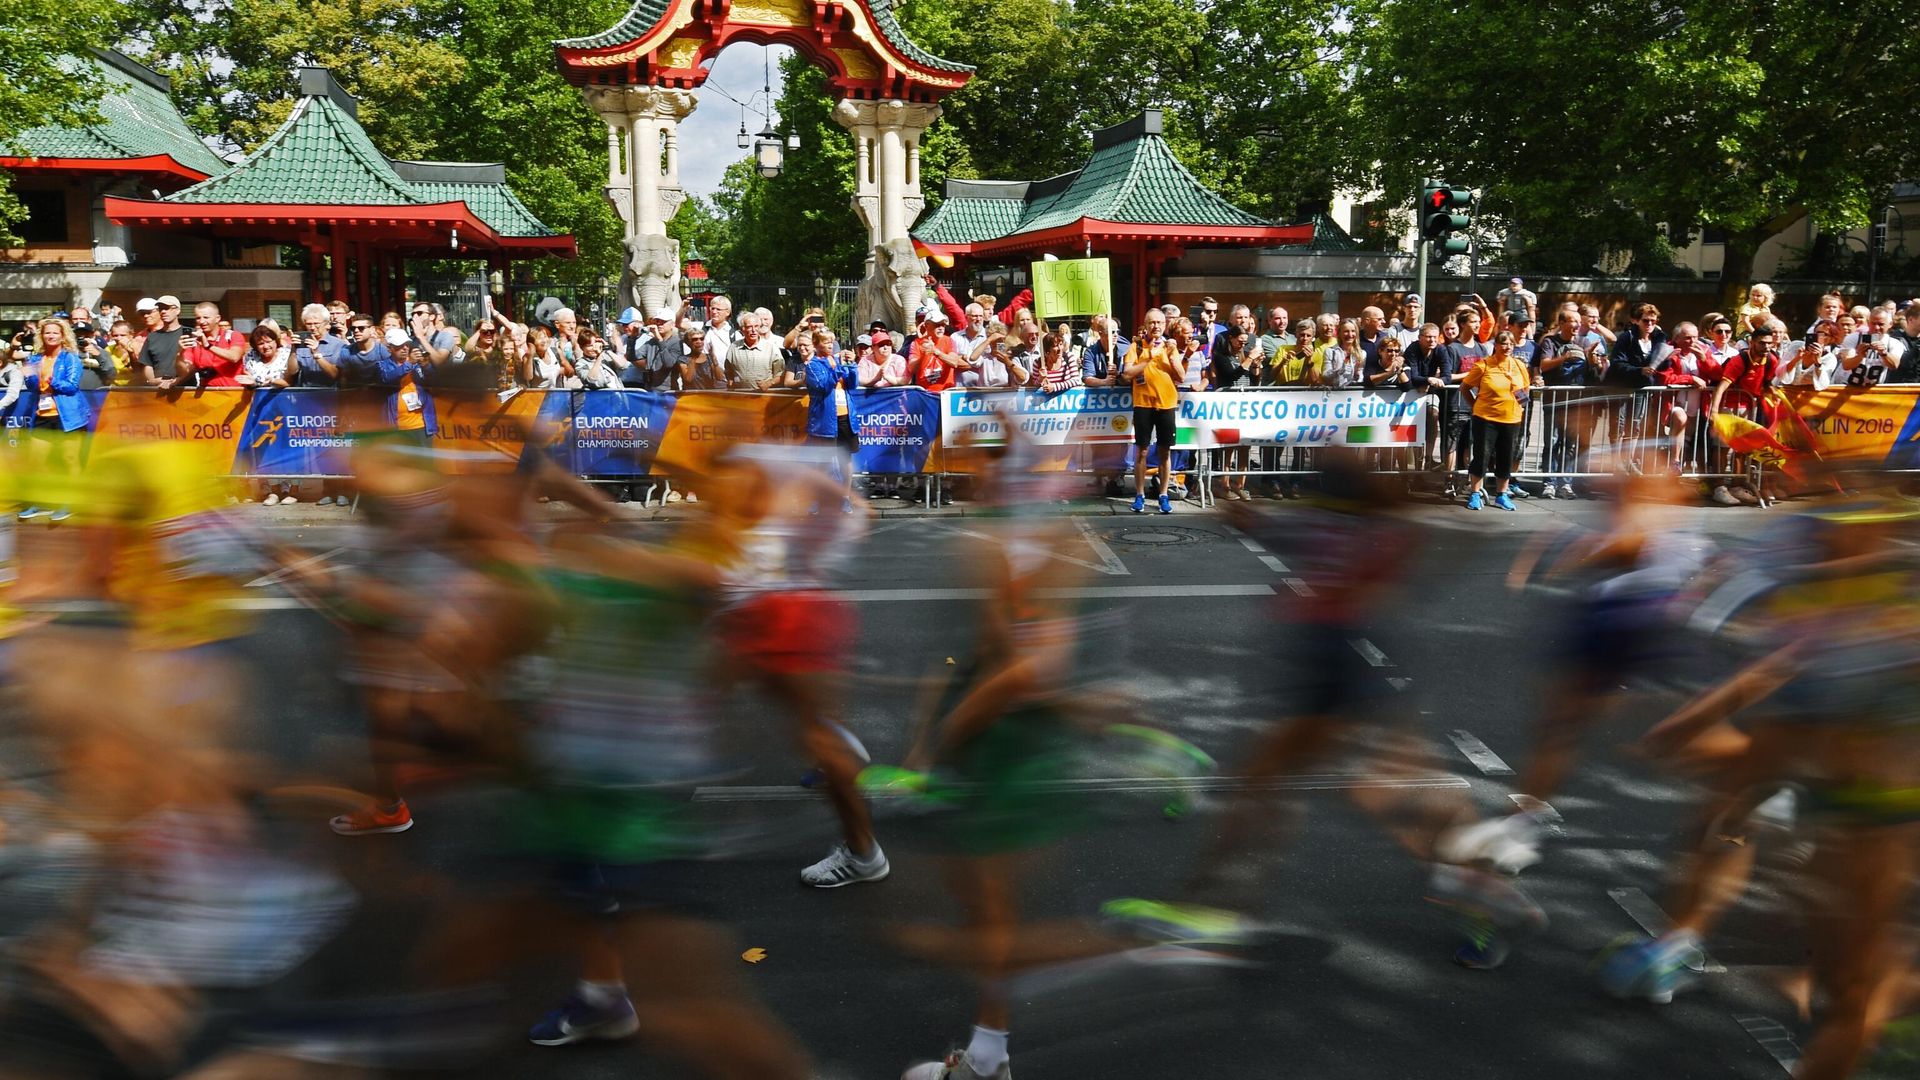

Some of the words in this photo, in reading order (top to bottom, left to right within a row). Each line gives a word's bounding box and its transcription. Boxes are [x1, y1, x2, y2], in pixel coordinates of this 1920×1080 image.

[1037, 262, 1062, 282] AUF
[1044, 289, 1109, 315] EMILIA
[1024, 392, 1133, 412] FRANCESCO
[1177, 399, 1289, 420] RANCESCO
[1295, 398, 1328, 419] noi
[1334, 397, 1352, 419] ci
[1357, 397, 1419, 418] siamo
[286, 415, 359, 428] EUROPE
[575, 416, 649, 429] EUROPEAN
[1813, 418, 1850, 435] RLIN
[1855, 417, 1894, 434] 2018
[117, 423, 187, 440] BERLIN
[191, 423, 233, 440] 2018
[577, 428, 635, 439] ATHLETICS
[1295, 424, 1339, 443] TU?
[577, 439, 649, 449] CHAMPIONSHIPS
[858, 436, 924, 446] HAMPIONSHIPS
